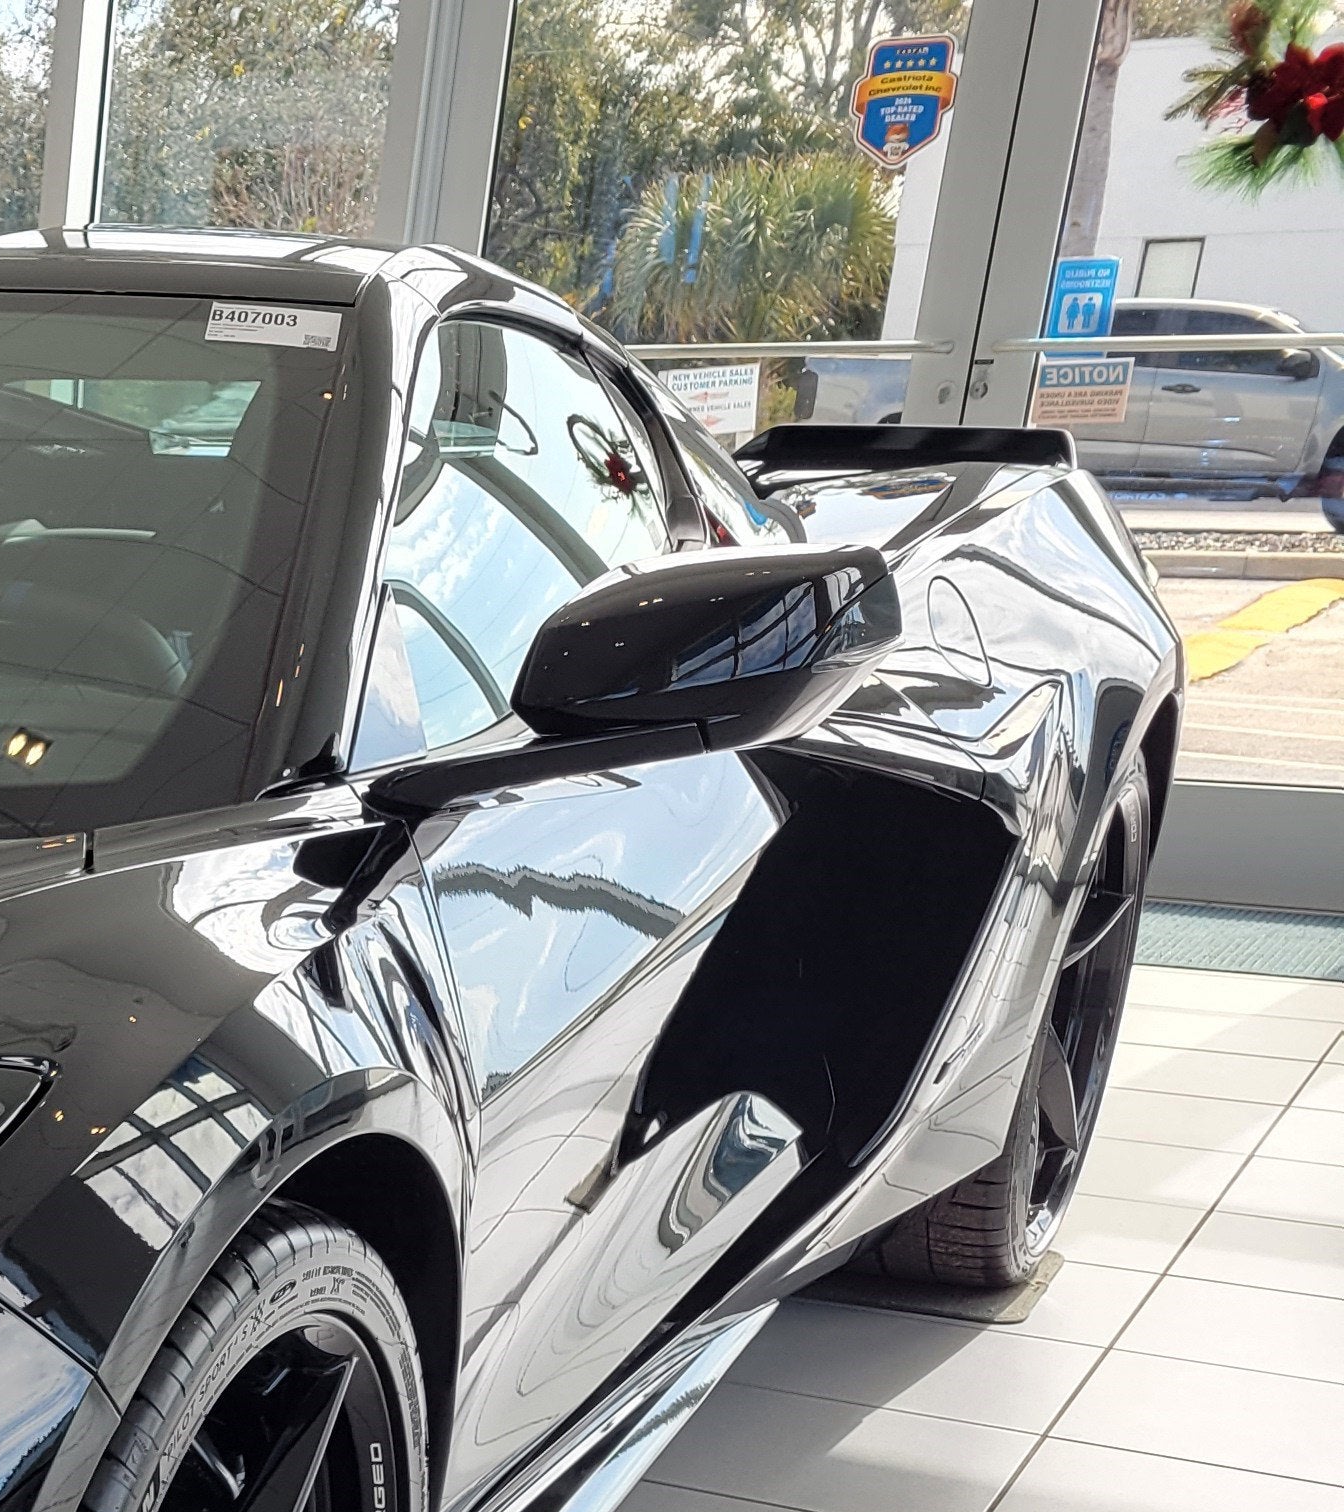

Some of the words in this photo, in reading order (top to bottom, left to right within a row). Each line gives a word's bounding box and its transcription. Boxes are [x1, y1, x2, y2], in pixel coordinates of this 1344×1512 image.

[880, 74, 934, 84] Castriota
[868, 83, 923, 97] Chevrolet
[884, 113, 917, 123] DEALER
[211, 308, 298, 328] B407003
[672, 373, 690, 382] NEW
[693, 369, 727, 380] VEHICLE
[729, 367, 754, 377] SALES
[671, 380, 716, 392] CUSTOMER
[718, 377, 753, 388] PARKING
[198, 1341, 234, 1403] SPORT
